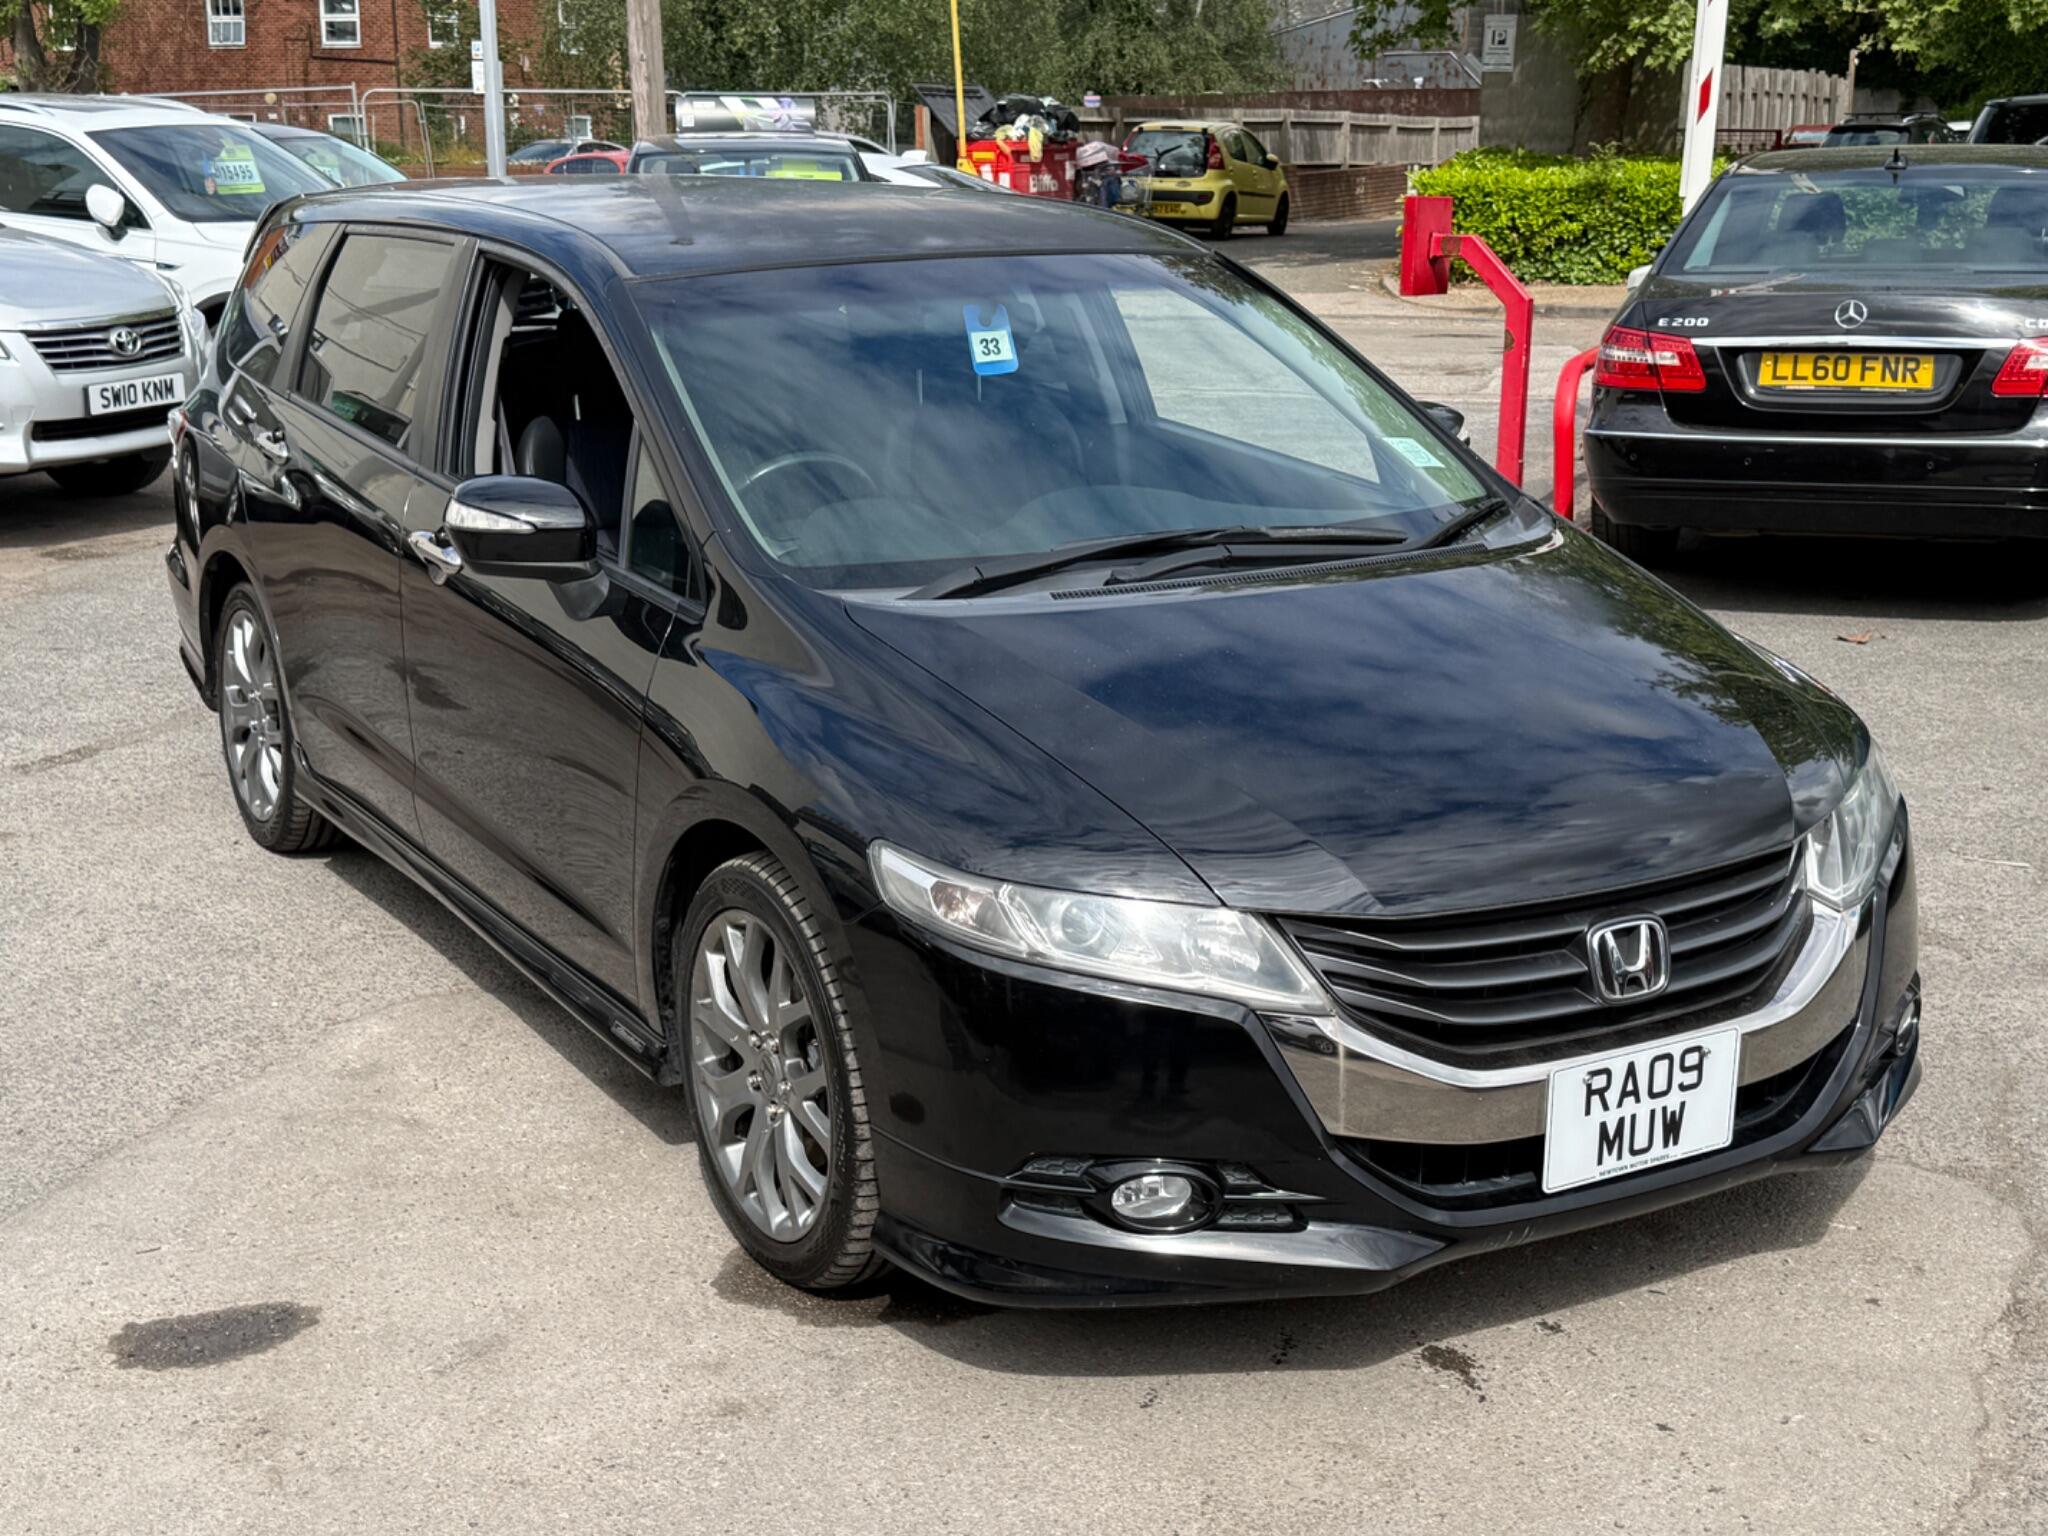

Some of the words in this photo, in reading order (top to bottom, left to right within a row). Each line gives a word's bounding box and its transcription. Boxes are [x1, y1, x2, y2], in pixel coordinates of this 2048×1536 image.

[1658, 317, 1669, 327] E
[1671, 317, 1709, 327] 200
[980, 337, 1001, 356] 33
[1771, 355, 1850, 381] LL60
[1860, 356, 1921, 384] FNR
[100, 383, 137, 409] SW10
[141, 378, 175, 403] KNM
[1585, 1045, 1705, 1116] RA09
[1597, 1100, 1687, 1166] MUW
